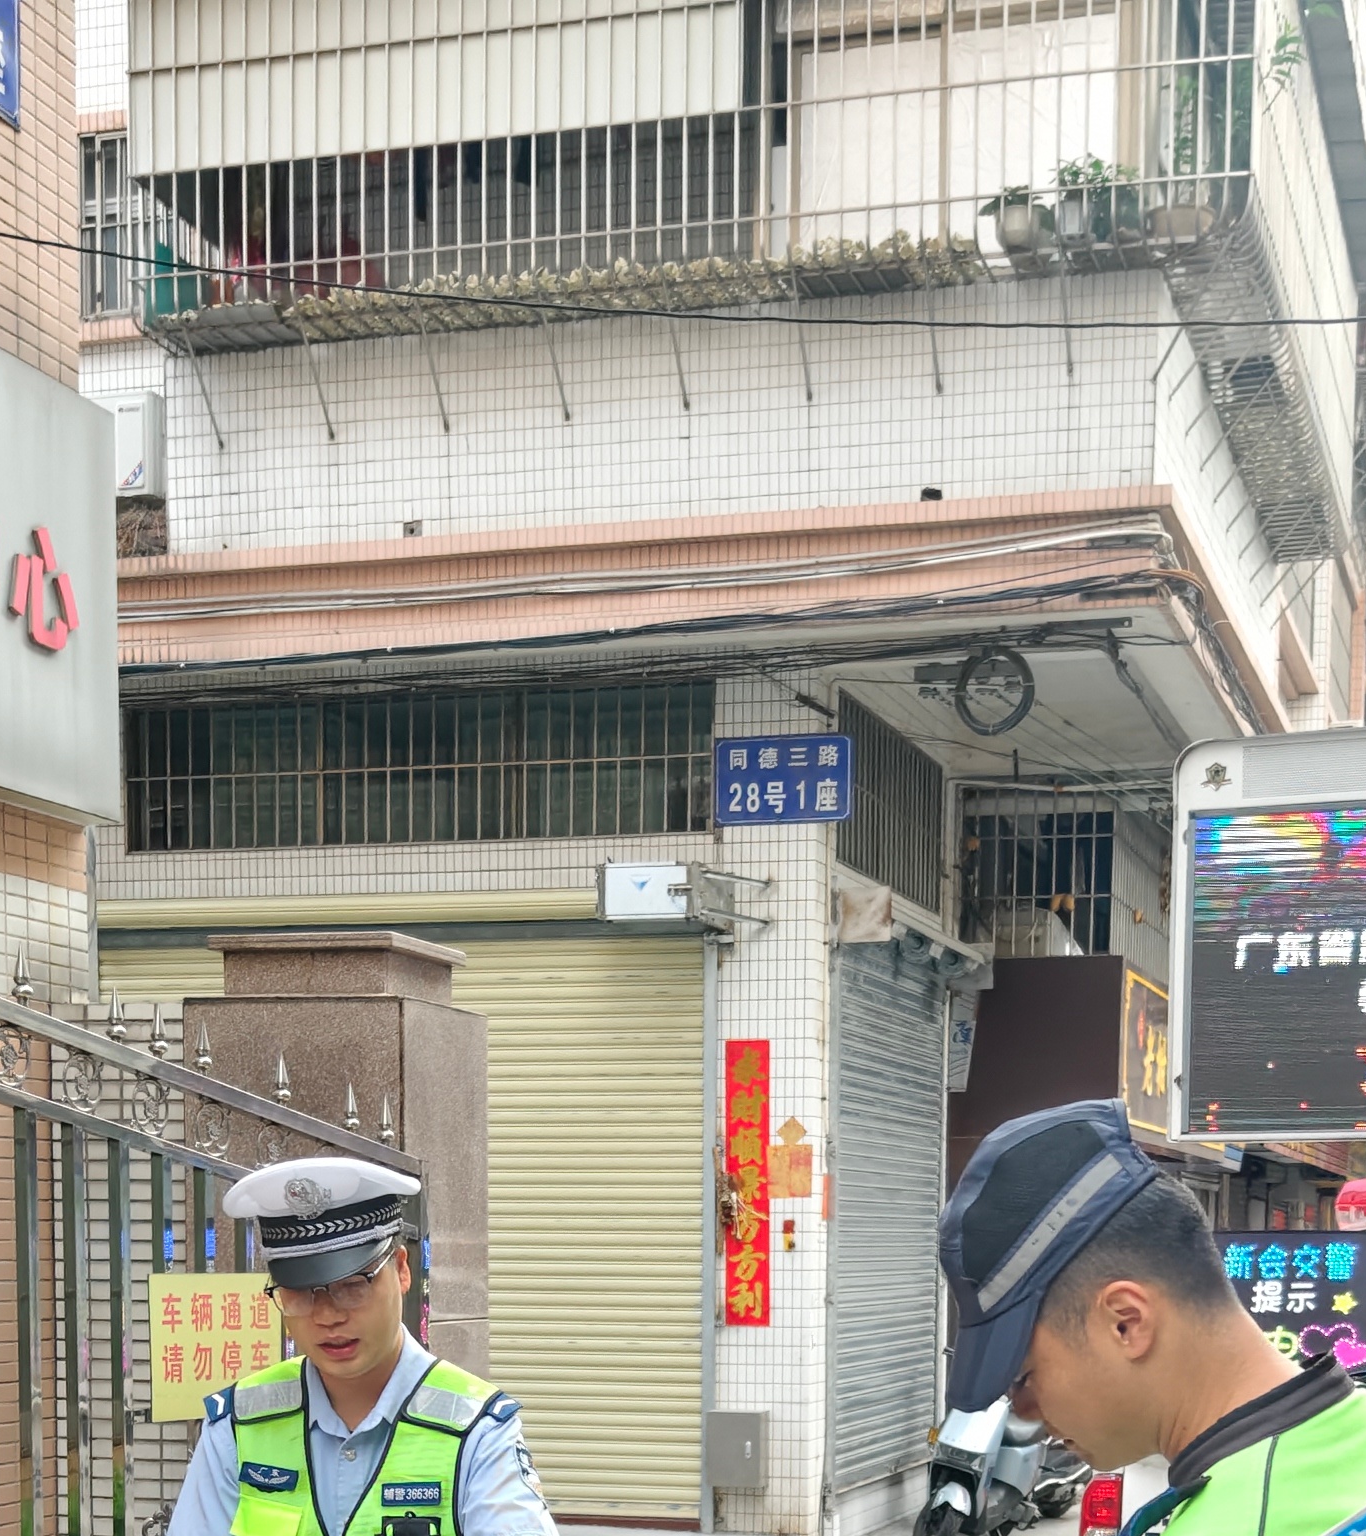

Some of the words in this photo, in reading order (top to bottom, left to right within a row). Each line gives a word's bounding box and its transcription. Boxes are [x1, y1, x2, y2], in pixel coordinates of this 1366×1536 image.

[728, 744, 839, 771] 同德三路
[1224, 1242, 1359, 1281] 新会交警
[161, 1292, 271, 1333] 车辆通道
[1251, 1280, 1318, 1314] 提示
[161, 1340, 271, 1384] 请勿停车
